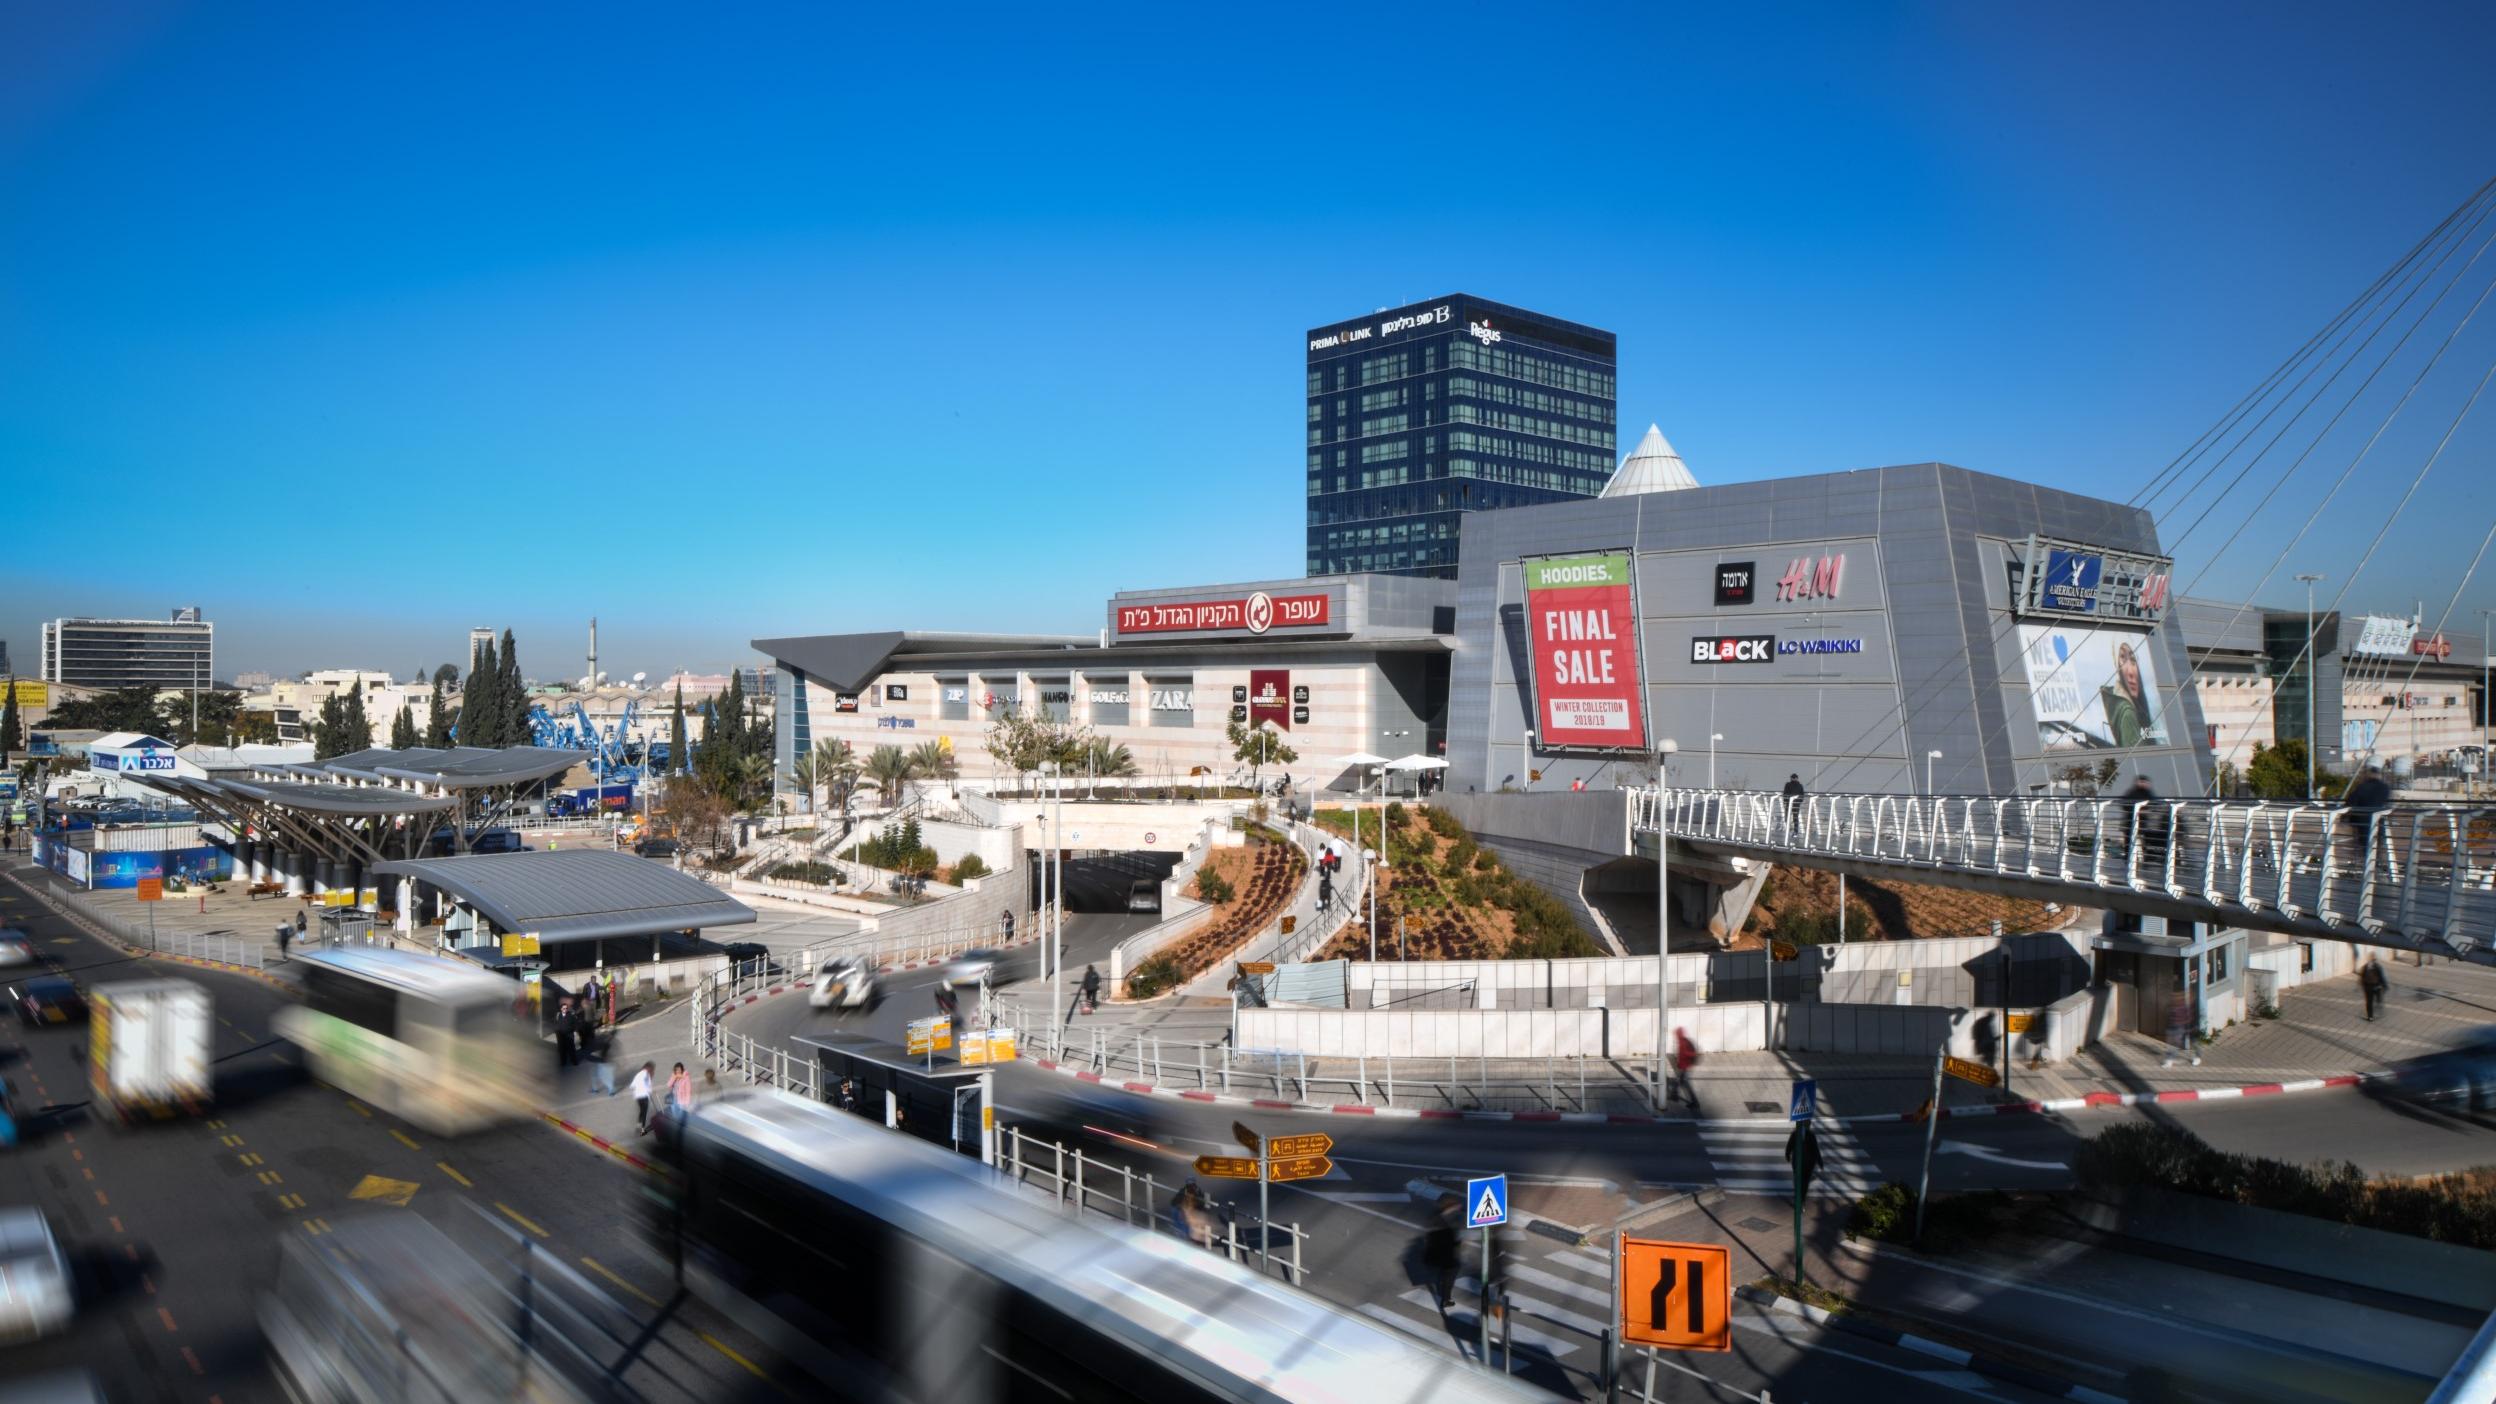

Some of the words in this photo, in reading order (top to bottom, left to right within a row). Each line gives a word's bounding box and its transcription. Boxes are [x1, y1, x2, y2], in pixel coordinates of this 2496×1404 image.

[1310, 336, 1339, 351] PRIMA
[1349, 327, 1372, 342] LINK
[1470, 320, 1501, 346] Regus
[1722, 571, 1749, 588] ארומה
[1776, 553, 1845, 602] H&M
[2049, 584, 2080, 598] AMERICAN
[1154, 606, 1193, 626] הגדול
[1196, 604, 1239, 628] הקניון
[1279, 600, 1320, 619] עופר
[1545, 609, 1617, 641] FINAL
[1778, 641, 1798, 655] LC
[2027, 635, 2054, 665] WE
[1553, 649, 1616, 685] SALE
[1151, 690, 1194, 711] ZARA
[1554, 701, 1580, 713] WINTER
[1582, 701, 1623, 713] COLLECTION
[2036, 687, 2081, 714] WARM
[142, 758, 173, 769] אלבר
